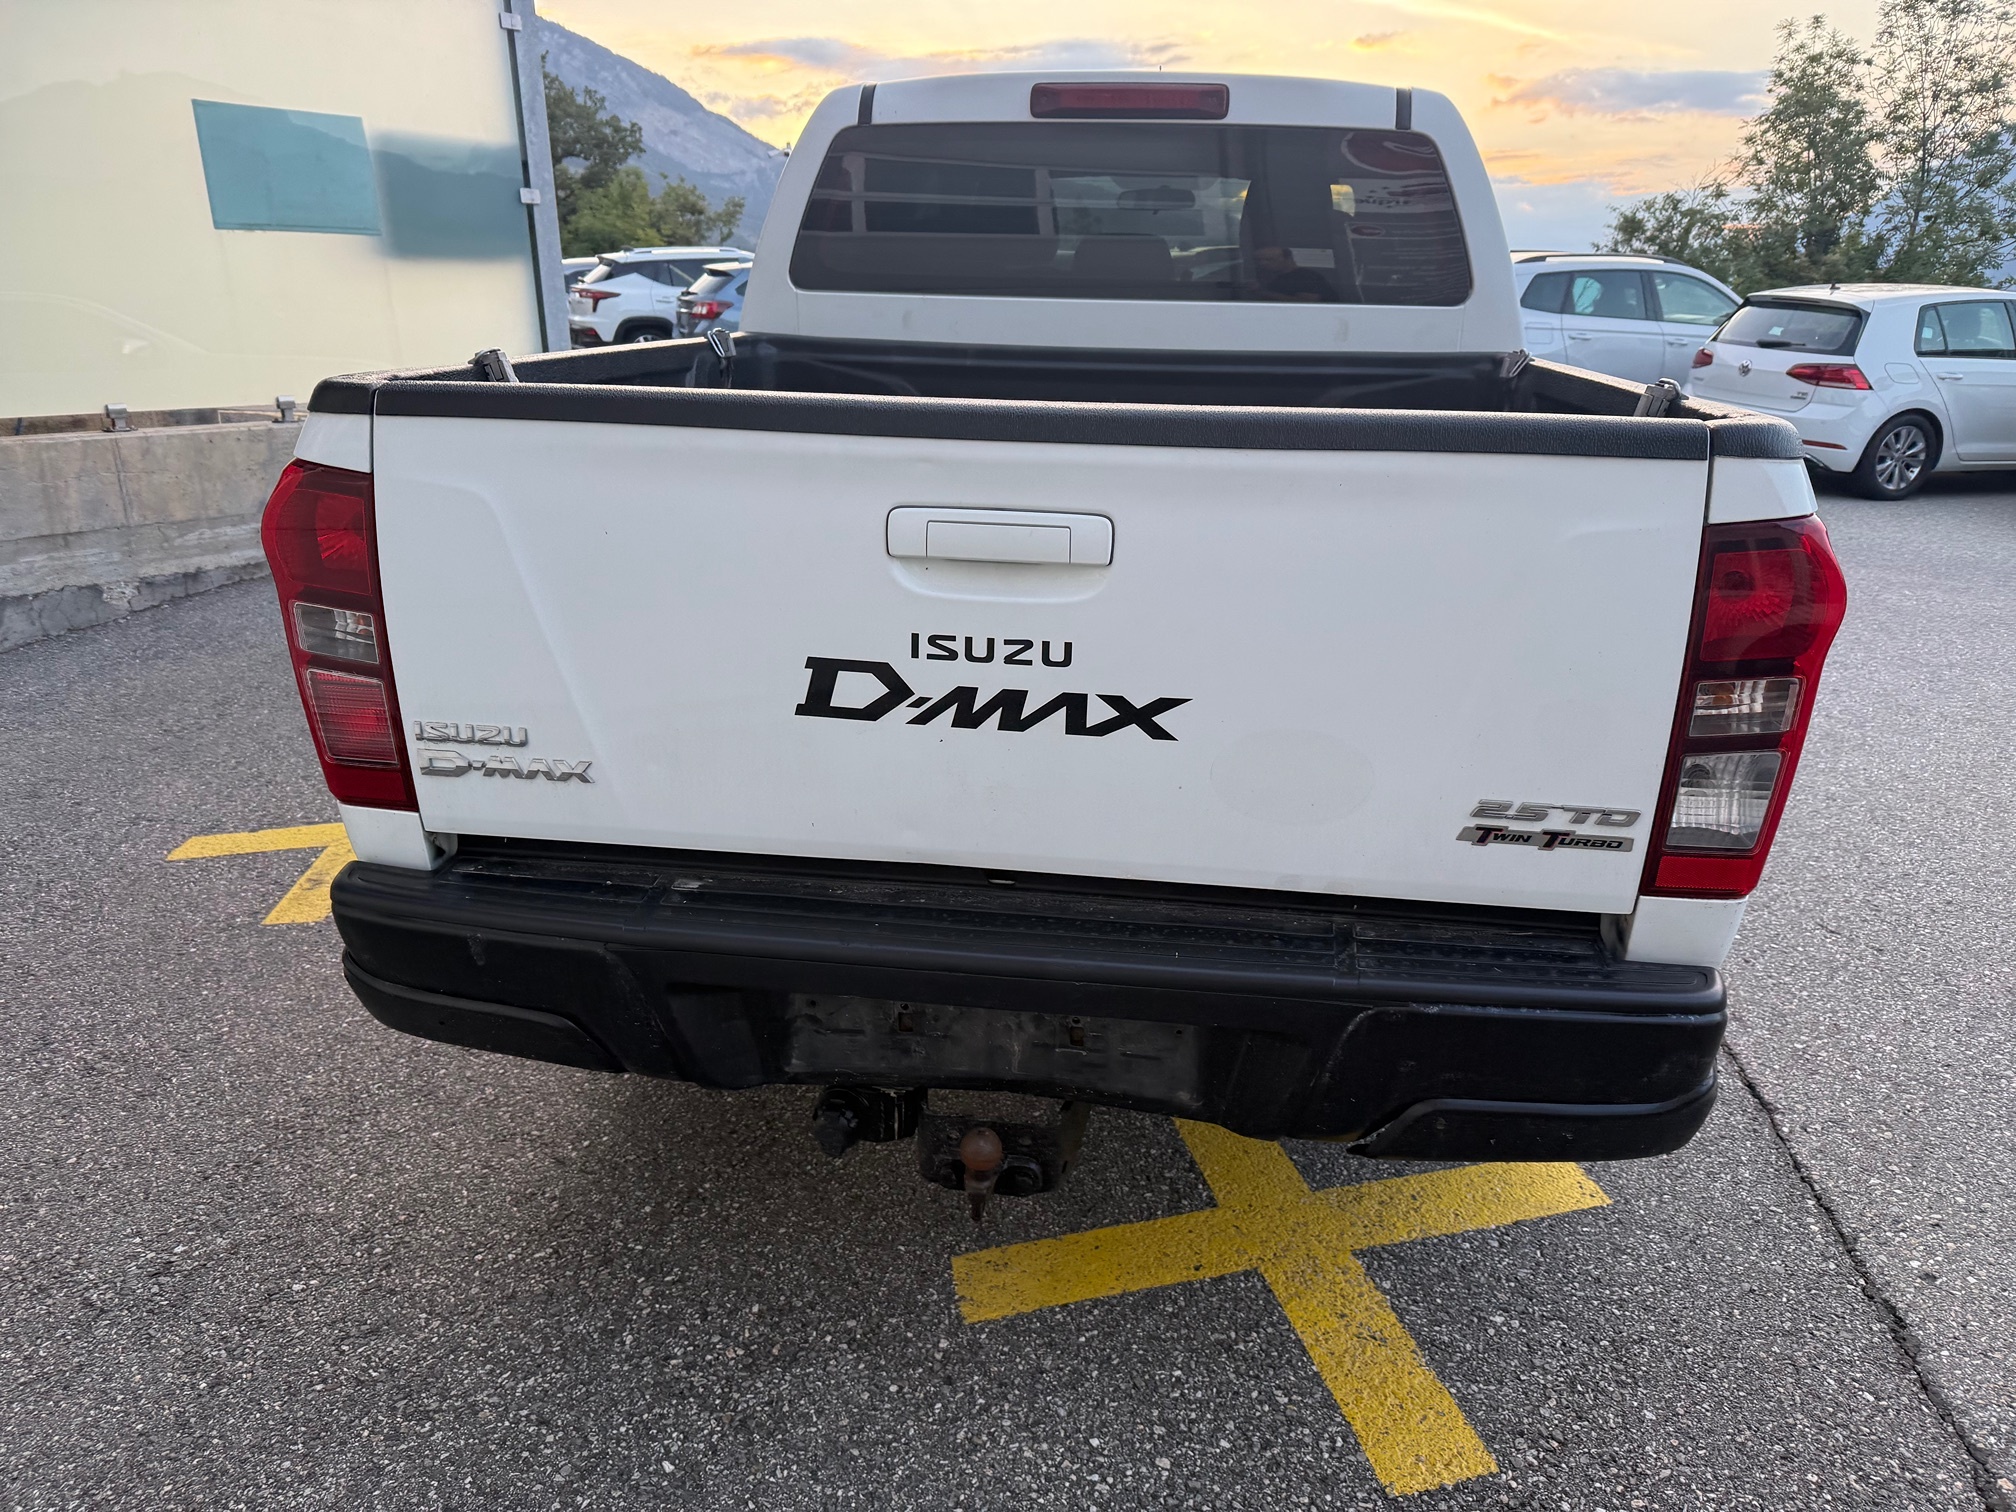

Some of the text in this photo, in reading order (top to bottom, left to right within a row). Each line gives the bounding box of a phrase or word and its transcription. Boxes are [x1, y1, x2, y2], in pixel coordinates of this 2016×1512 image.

[910, 632, 1073, 668] ISUZU
[794, 656, 1194, 741] D-MAX
[414, 720, 528, 748] ISUZU
[417, 748, 595, 784] D-MAX
[1561, 804, 1642, 827] TD
[1475, 826, 1624, 849] TWIN TURBO
